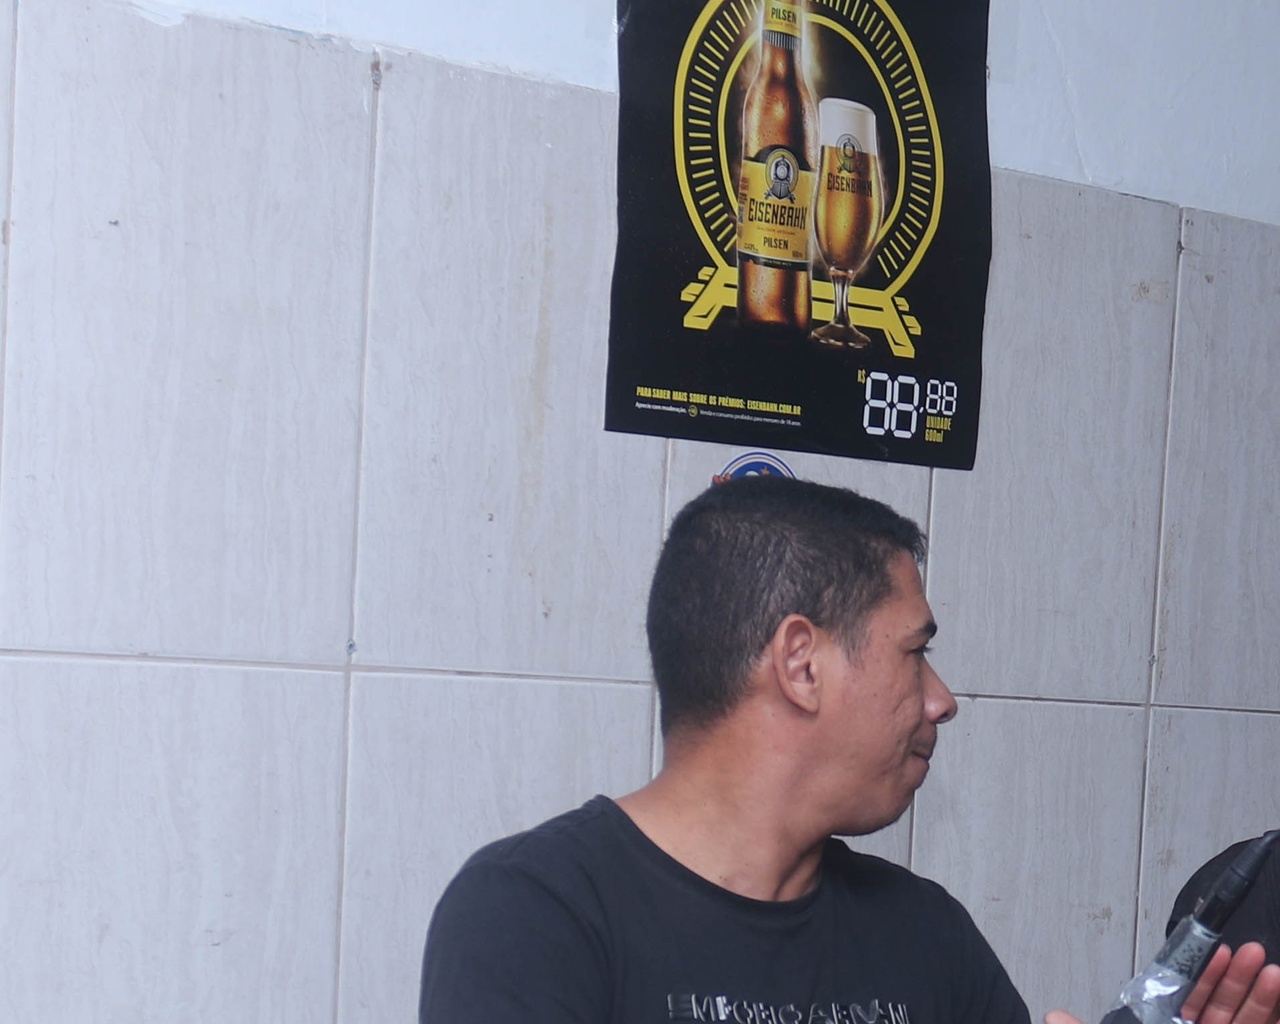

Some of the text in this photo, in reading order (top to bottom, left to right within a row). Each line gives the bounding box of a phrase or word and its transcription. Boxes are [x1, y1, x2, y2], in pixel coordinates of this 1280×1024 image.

[770, 7, 797, 25] PILSEN
[827, 173, 873, 198] EISENBAHN
[748, 198, 808, 230] EISENBAHN
[763, 236, 789, 250] PILSEN
[857, 369, 866, 384] R$
[636, 386, 652, 398] PARA
[652, 388, 671, 400] SABER
[672, 390, 688, 402] MAIS
[689, 392, 708, 405] SOBRE
[709, 395, 717, 406] OS
[926, 416, 952, 430] UNIDADE
